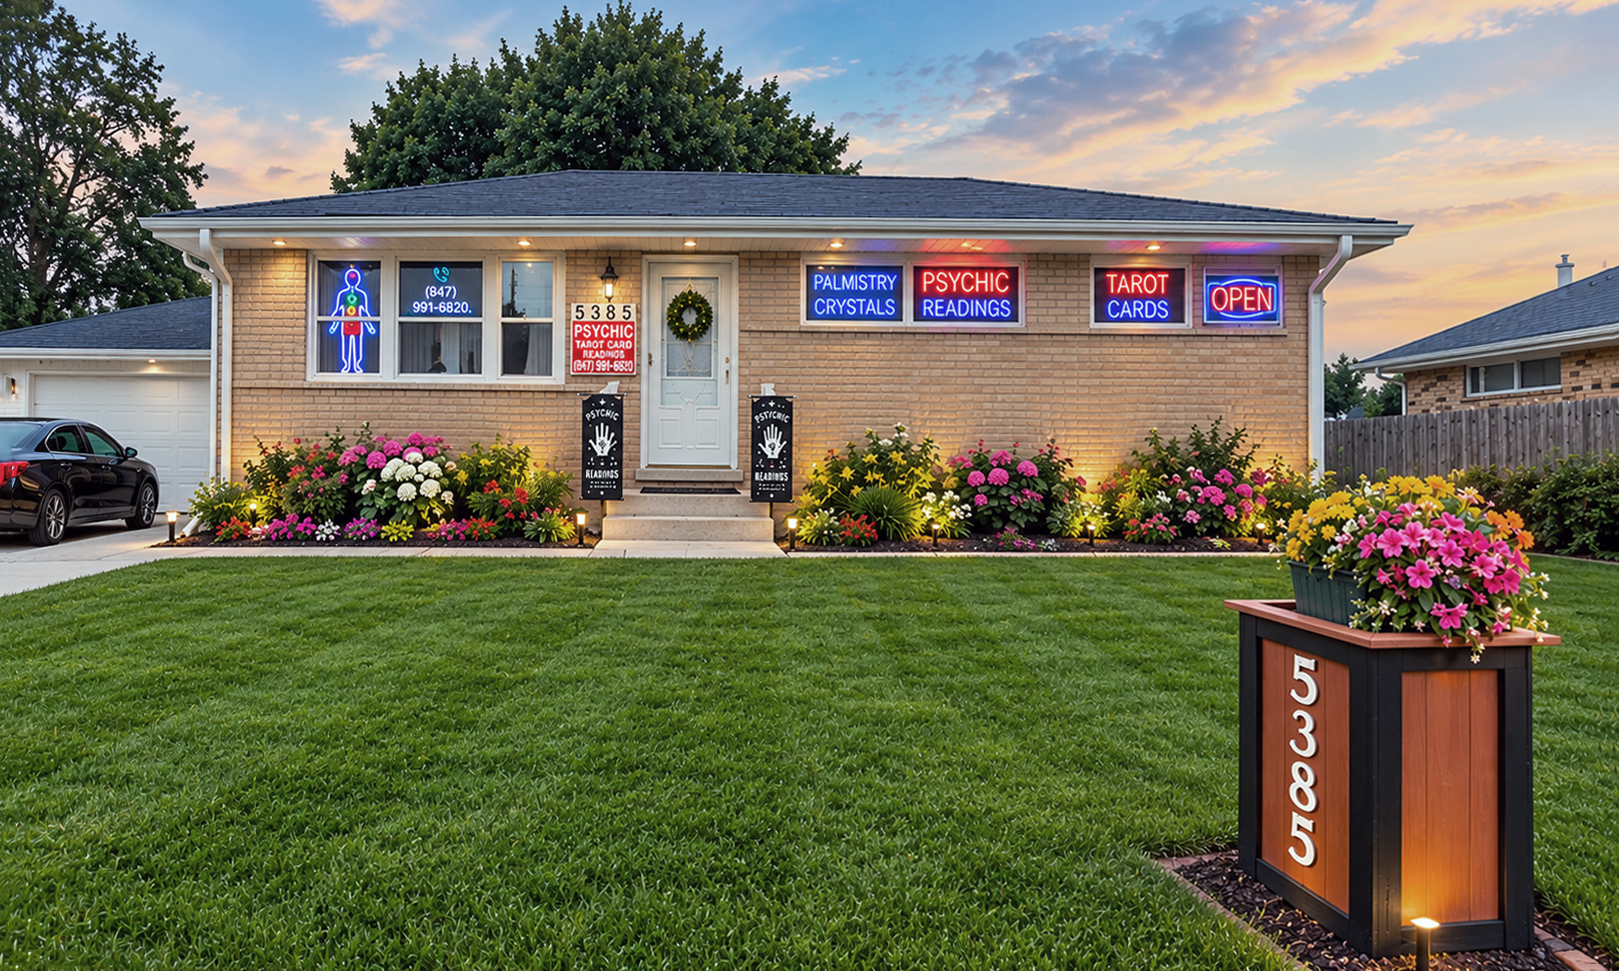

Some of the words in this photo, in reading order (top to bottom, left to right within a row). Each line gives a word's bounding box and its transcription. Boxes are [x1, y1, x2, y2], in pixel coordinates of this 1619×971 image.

[813, 273, 898, 291] PALMISTRY
[922, 271, 1010, 293] PSYCHIC
[1105, 273, 1170, 294] TAROT
[425, 285, 457, 299] (847)
[1211, 286, 1273, 312] OPEN
[813, 297, 896, 316] CRYSTALS
[922, 298, 1012, 318] READINGS
[1107, 299, 1170, 319] CARDS
[574, 324, 634, 339] PSYCHIC
[575, 340, 605, 350] TAROT
[606, 340, 633, 350] CARD
[585, 408, 620, 422] PSYCHIC
